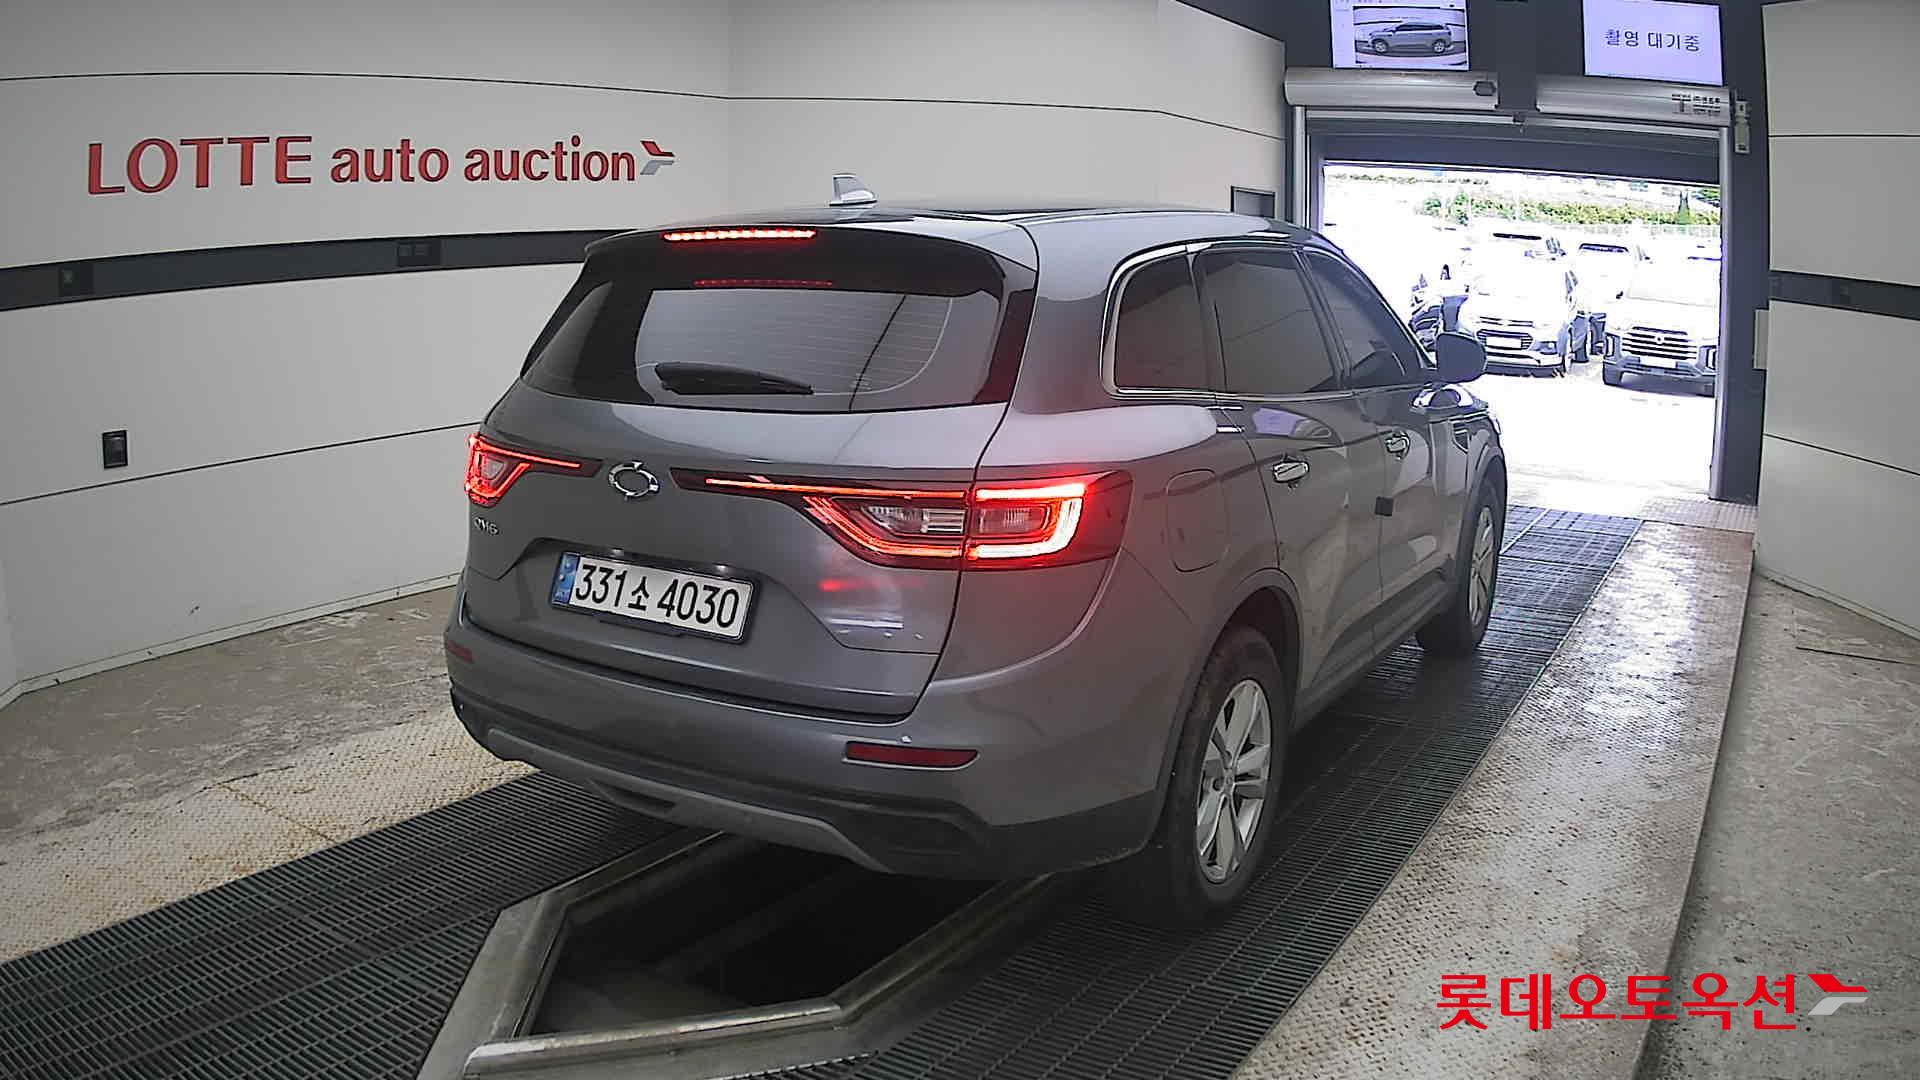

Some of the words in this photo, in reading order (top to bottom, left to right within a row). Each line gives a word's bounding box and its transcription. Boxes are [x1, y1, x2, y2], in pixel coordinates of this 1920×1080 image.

[1647, 32, 1699, 52] 대기중
[88, 136, 312, 195] LOTTE
[330, 138, 450, 183] auto
[464, 136, 636, 182] auction
